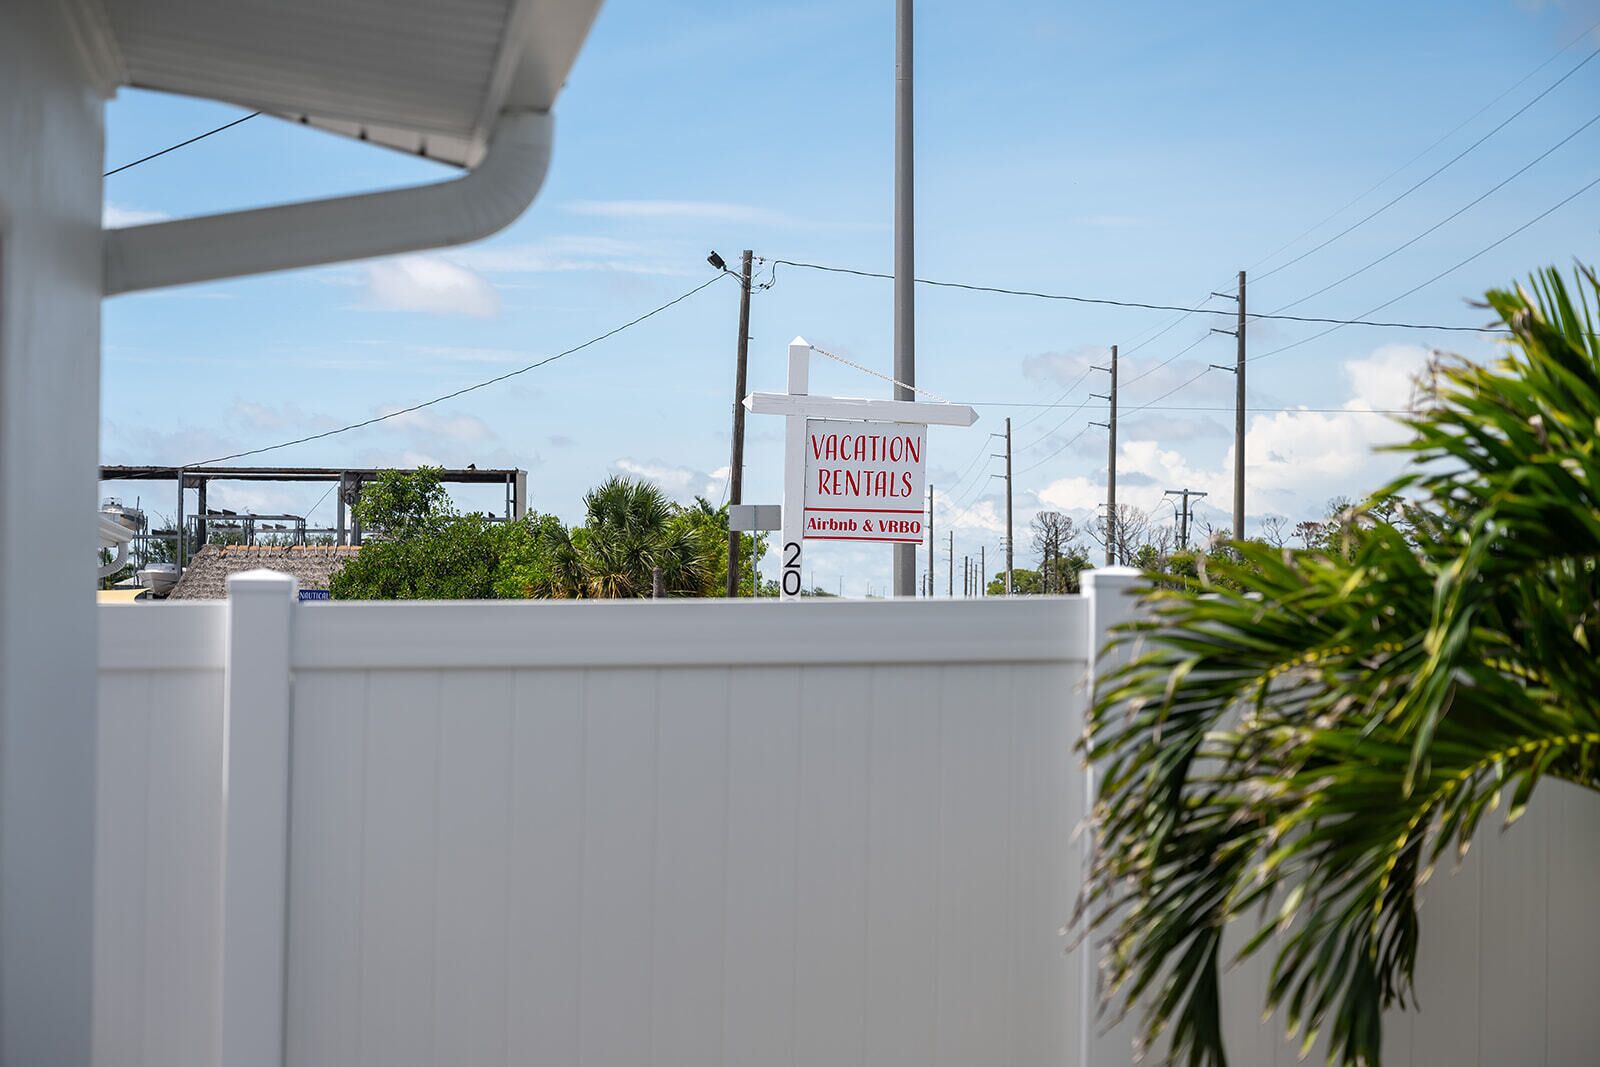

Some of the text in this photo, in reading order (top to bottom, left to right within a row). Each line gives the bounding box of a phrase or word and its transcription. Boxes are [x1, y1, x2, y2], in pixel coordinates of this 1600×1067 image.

[811, 434, 921, 463] VACATION
[818, 469, 912, 498] RENTALS
[807, 517, 921, 534] Airbnb & VRBO
[783, 542, 801, 600] 20
